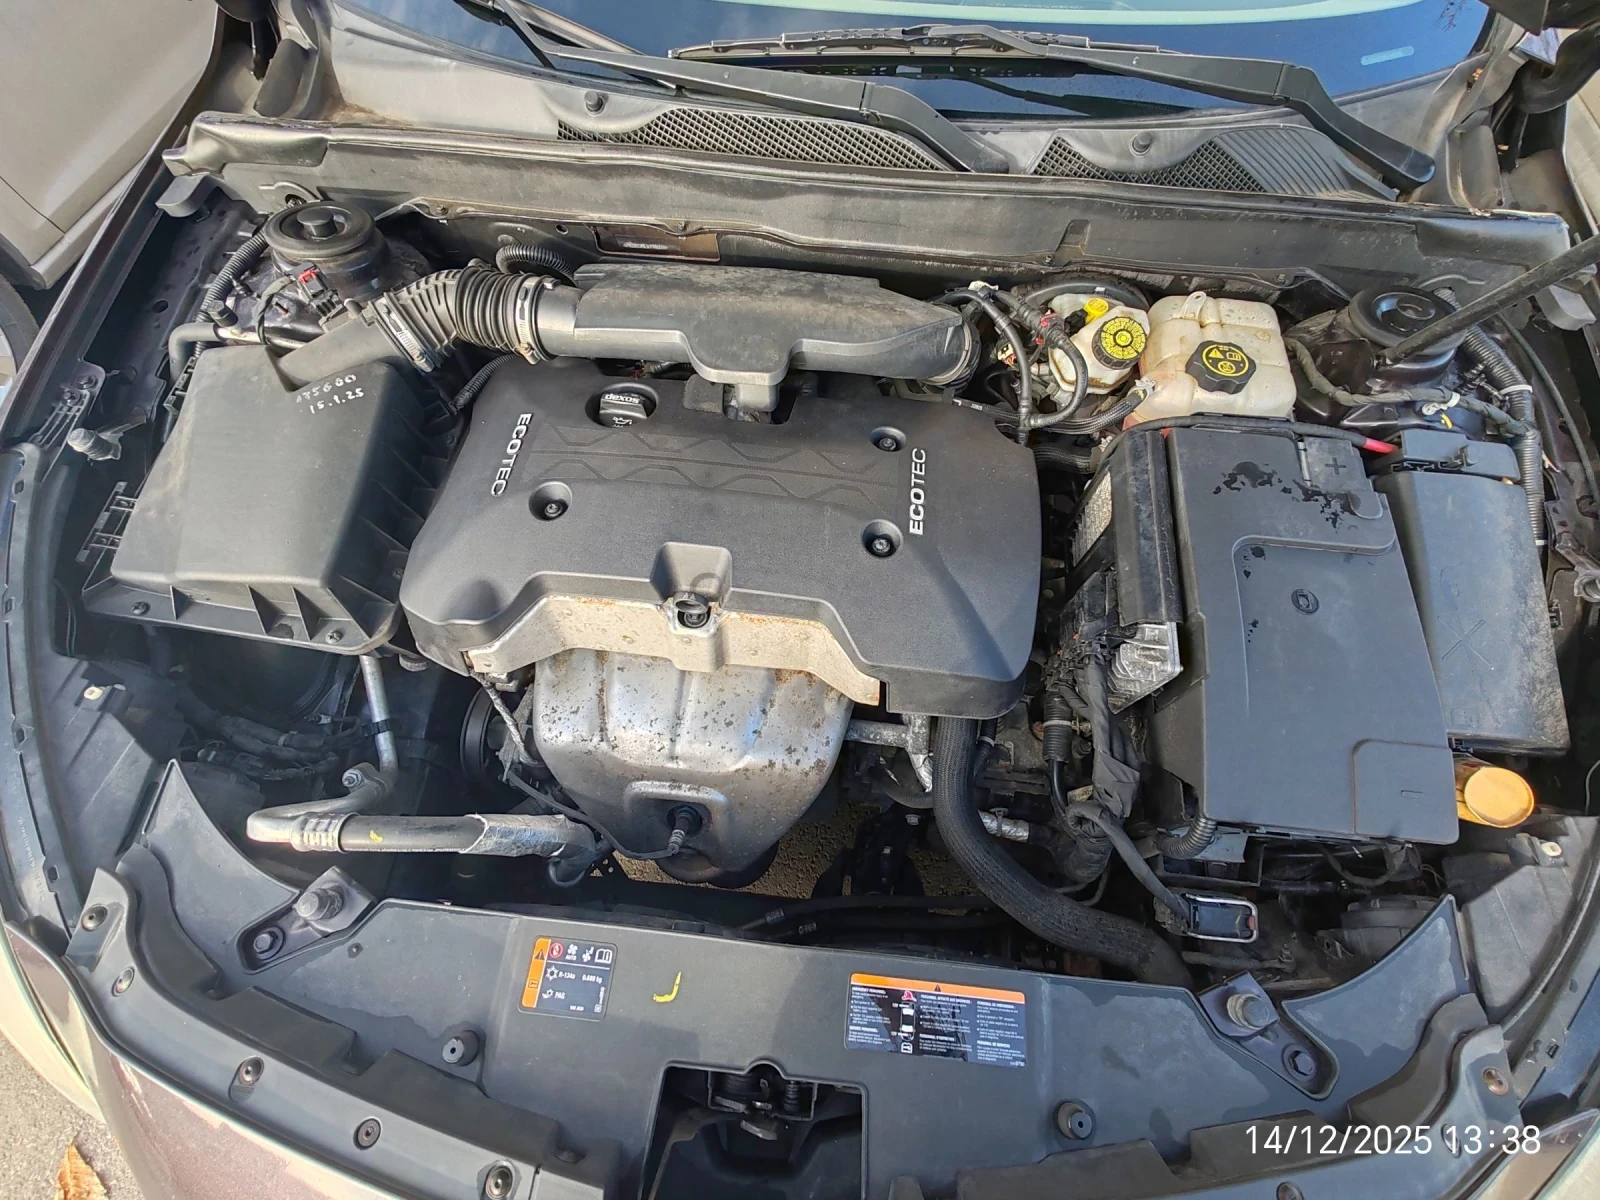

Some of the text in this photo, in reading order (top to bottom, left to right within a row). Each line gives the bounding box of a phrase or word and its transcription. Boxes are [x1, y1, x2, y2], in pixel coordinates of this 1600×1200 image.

[604, 393, 640, 404] dexos
[491, 413, 532, 496] ECOTEC
[909, 448, 926, 535] ECOTEC
[595, 976, 603, 984] kg
[554, 991, 566, 1000] PAG
